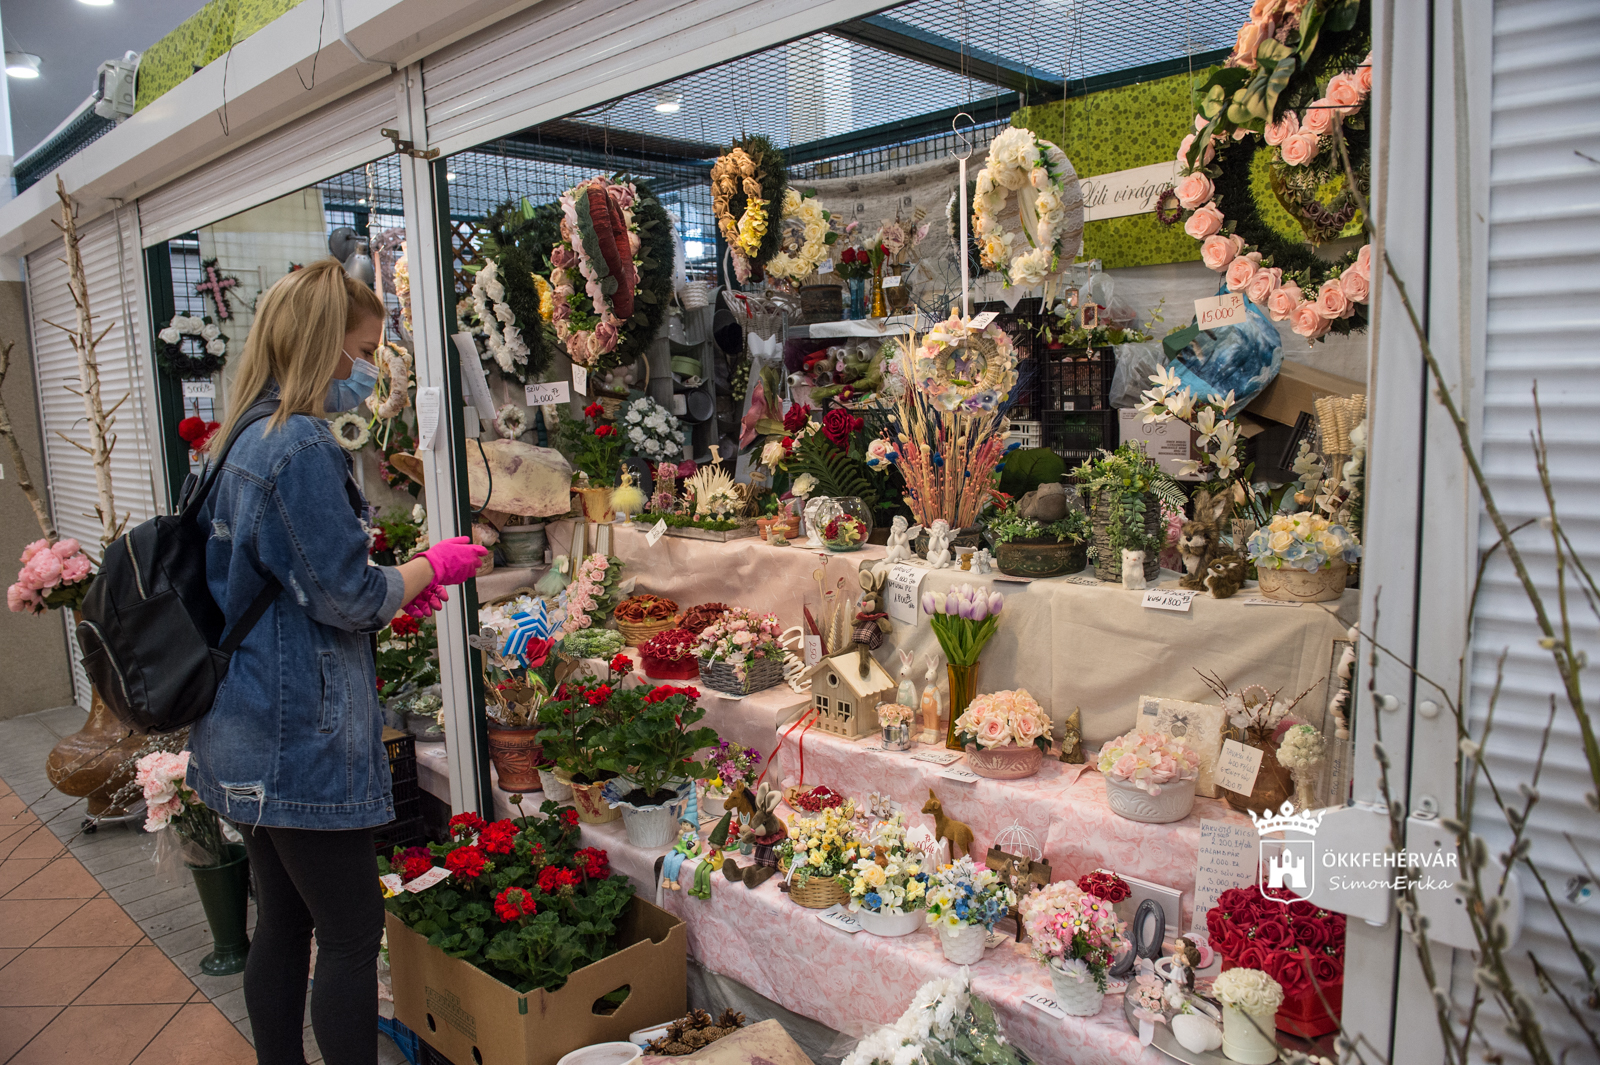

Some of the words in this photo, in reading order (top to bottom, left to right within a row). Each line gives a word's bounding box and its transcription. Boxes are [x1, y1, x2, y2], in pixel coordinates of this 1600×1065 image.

[1080, 181, 1108, 208] Lili
[1114, 177, 1173, 210] virága
[1141, 422, 1168, 436] 20
[808, 641, 817, 659] 250
